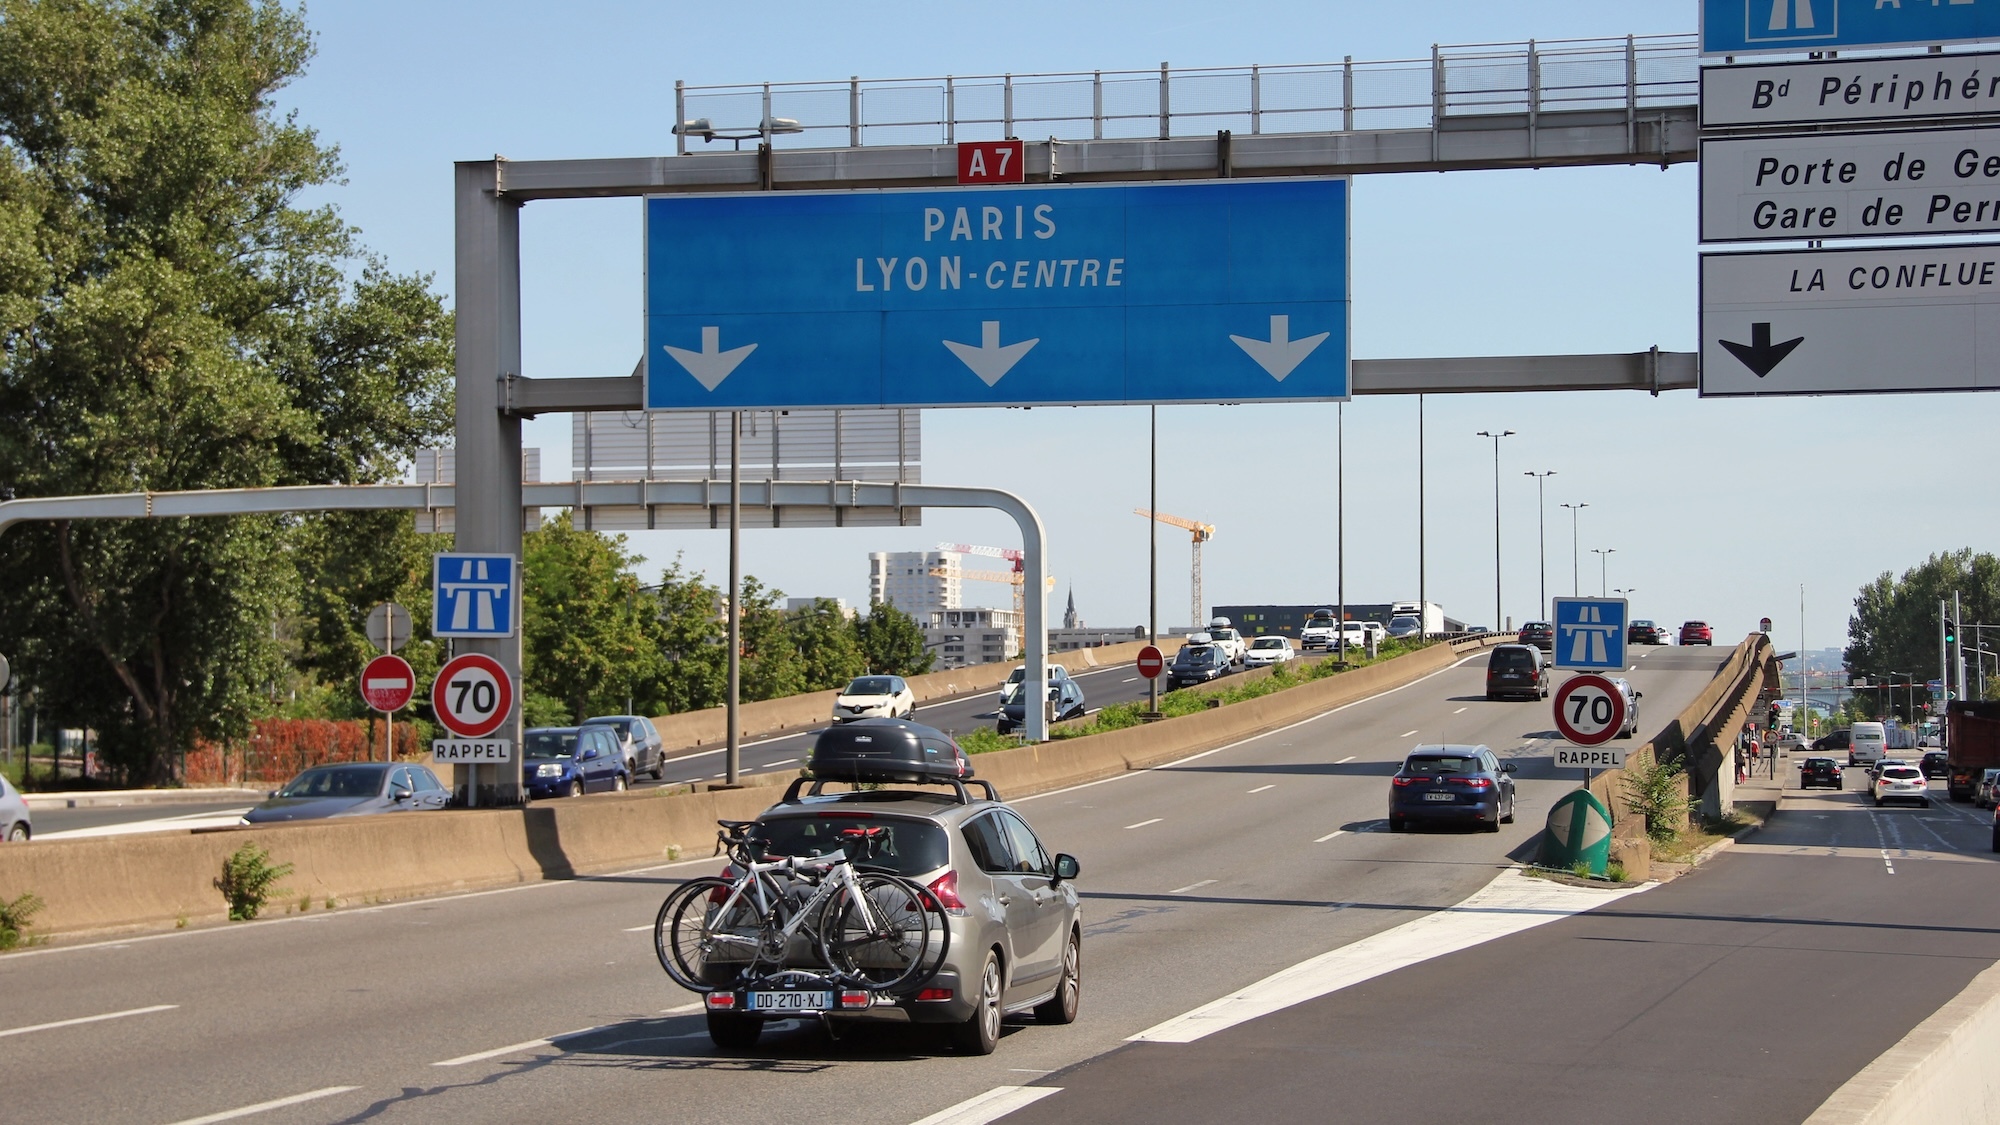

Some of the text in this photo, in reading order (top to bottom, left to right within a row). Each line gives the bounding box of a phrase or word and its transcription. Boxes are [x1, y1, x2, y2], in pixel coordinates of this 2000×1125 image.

[1756, 149, 2000, 187] Porte de Ge
[924, 203, 1056, 242] PARIS
[1753, 200, 1837, 230] Gare
[1862, 197, 1903, 227] de
[1790, 261, 1995, 293] LA CONFLUE
[451, 680, 496, 714] 70
[1569, 695, 1613, 725] 70
[436, 744, 507, 758] RAPPEL
[1560, 751, 1620, 765] RAPPEL
[756, 993, 824, 1008] DD-270-XJ
